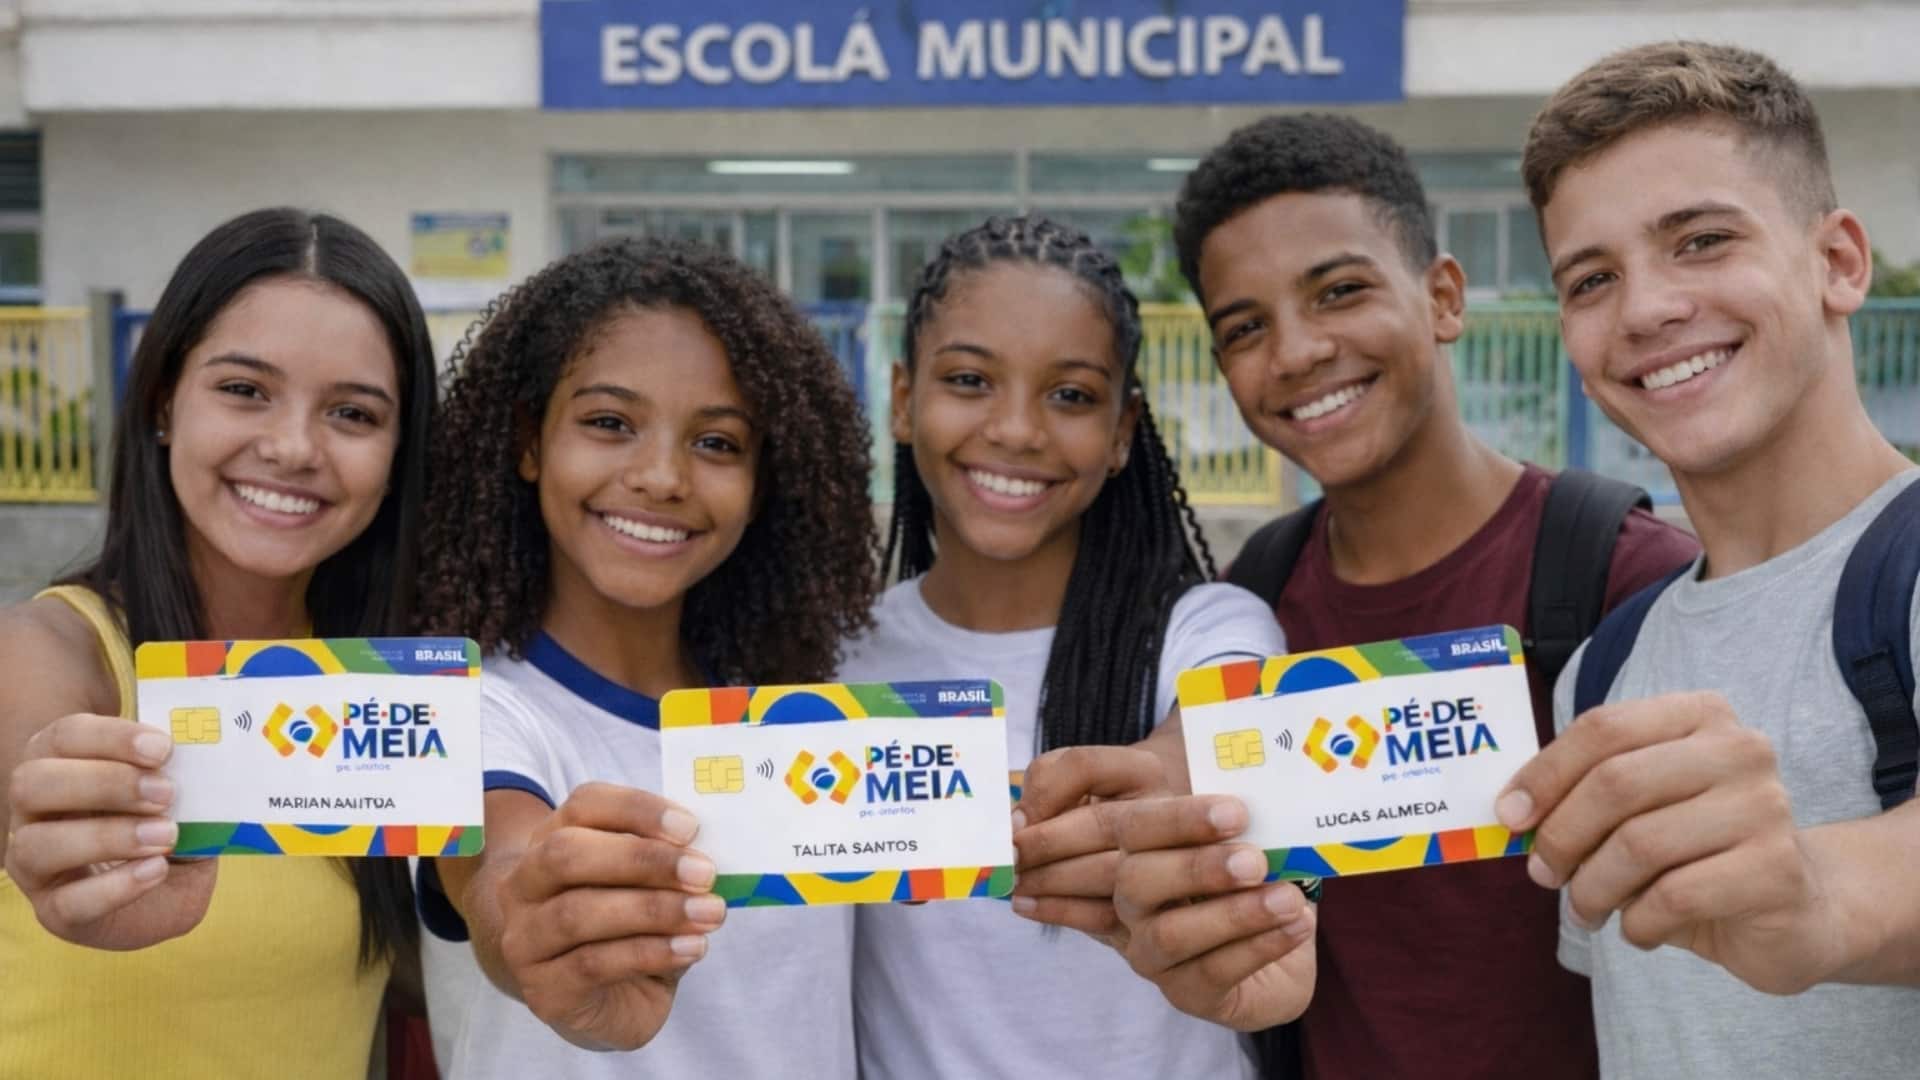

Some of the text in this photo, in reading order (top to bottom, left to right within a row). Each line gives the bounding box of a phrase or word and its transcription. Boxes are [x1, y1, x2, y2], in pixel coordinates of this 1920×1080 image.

[918, 14, 1343, 80] MUNICIPAL
[414, 648, 467, 662] BRASIL
[1450, 638, 1508, 656] BRASIL
[938, 689, 992, 703] BRASIL
[342, 728, 448, 760] MEIA
[1386, 723, 1501, 766] MEIA
[866, 769, 974, 804] MEIA
[1315, 810, 1371, 829] LUCAS
[792, 839, 919, 857] TALITA SANTOS
